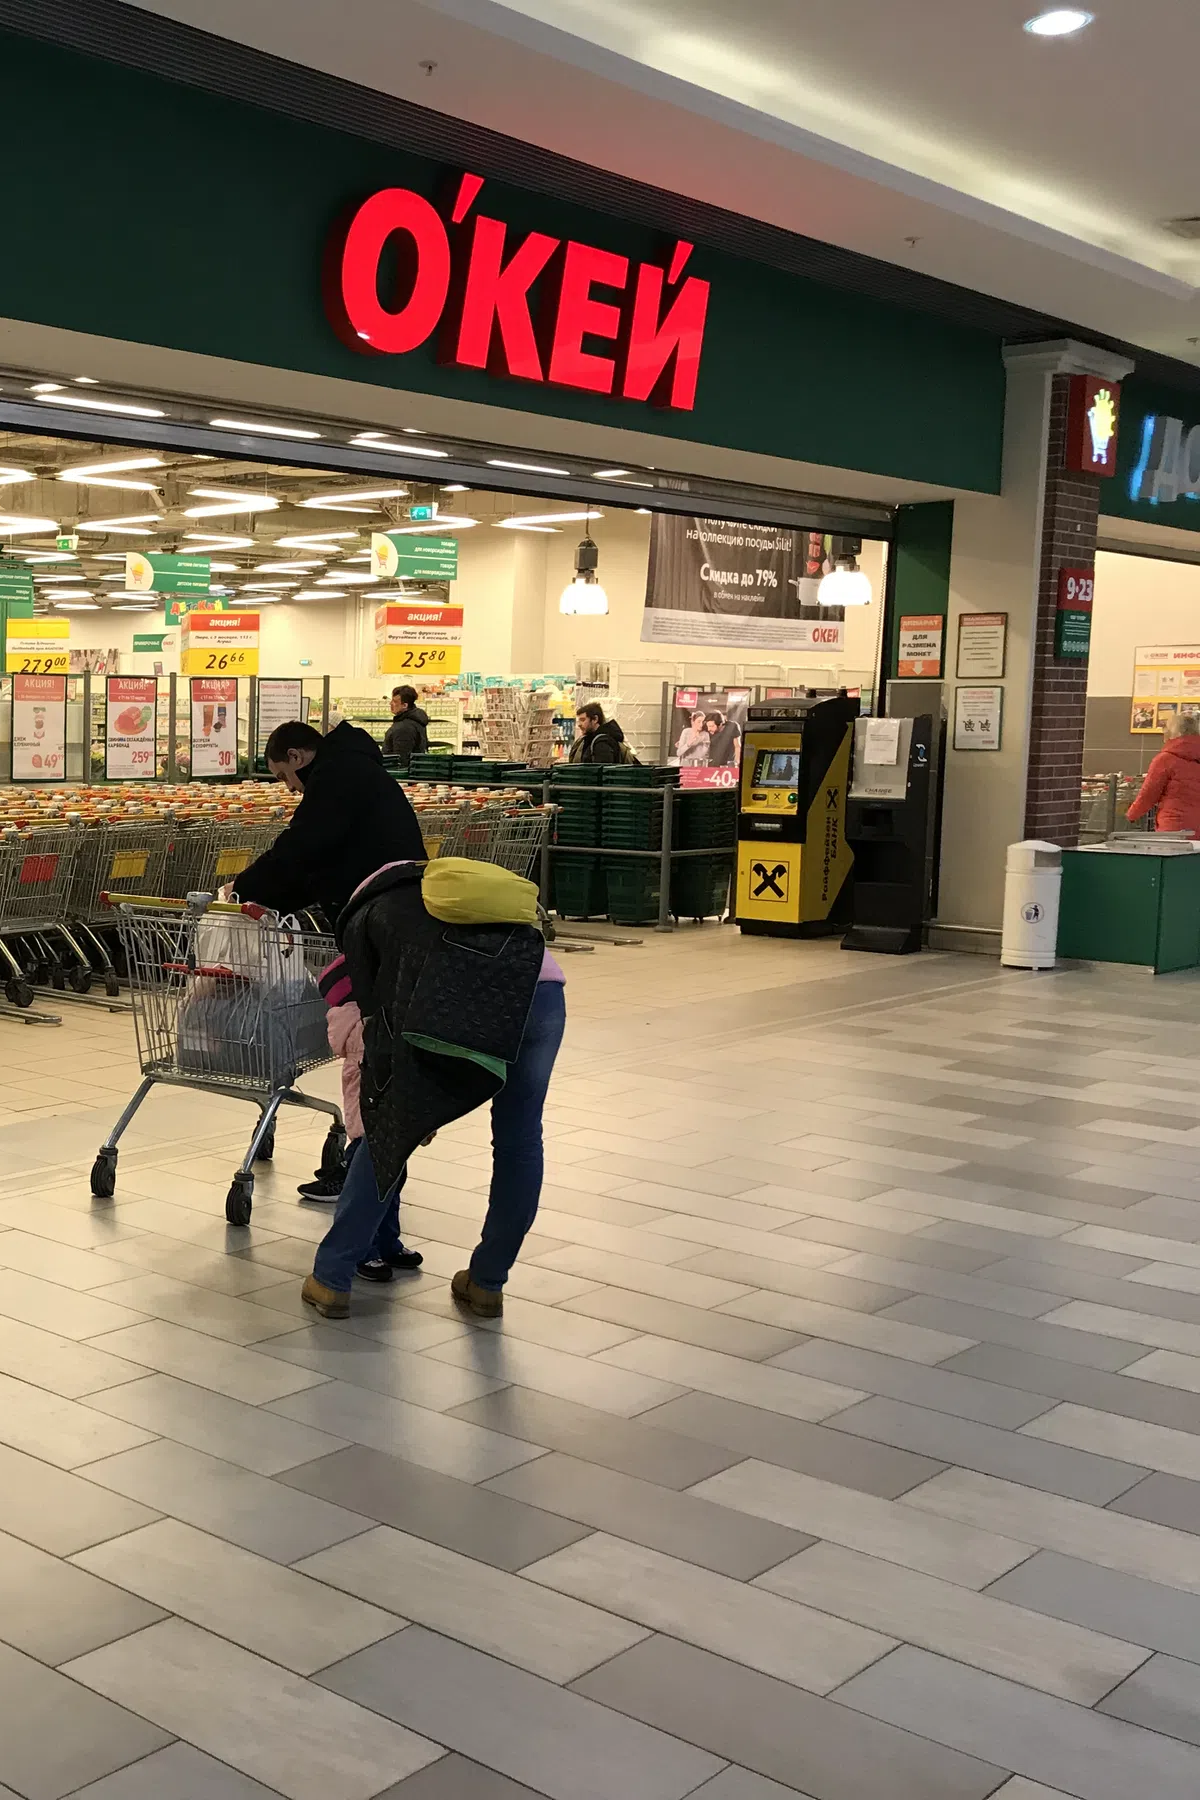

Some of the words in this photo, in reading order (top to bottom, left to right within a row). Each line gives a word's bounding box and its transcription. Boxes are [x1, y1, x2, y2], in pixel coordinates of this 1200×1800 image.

[342, 172, 711, 411] О'КЕЙ
[686, 529, 698, 540] на
[745, 538, 775, 551] посуды
[700, 562, 739, 585] Скидка
[740, 573, 754, 587] до
[755, 569, 778, 588] 79%
[209, 618, 241, 627] акция!
[407, 612, 443, 622] акция!
[24, 679, 55, 689] АКЦИЯ!
[830, 817, 838, 859] БАНК
